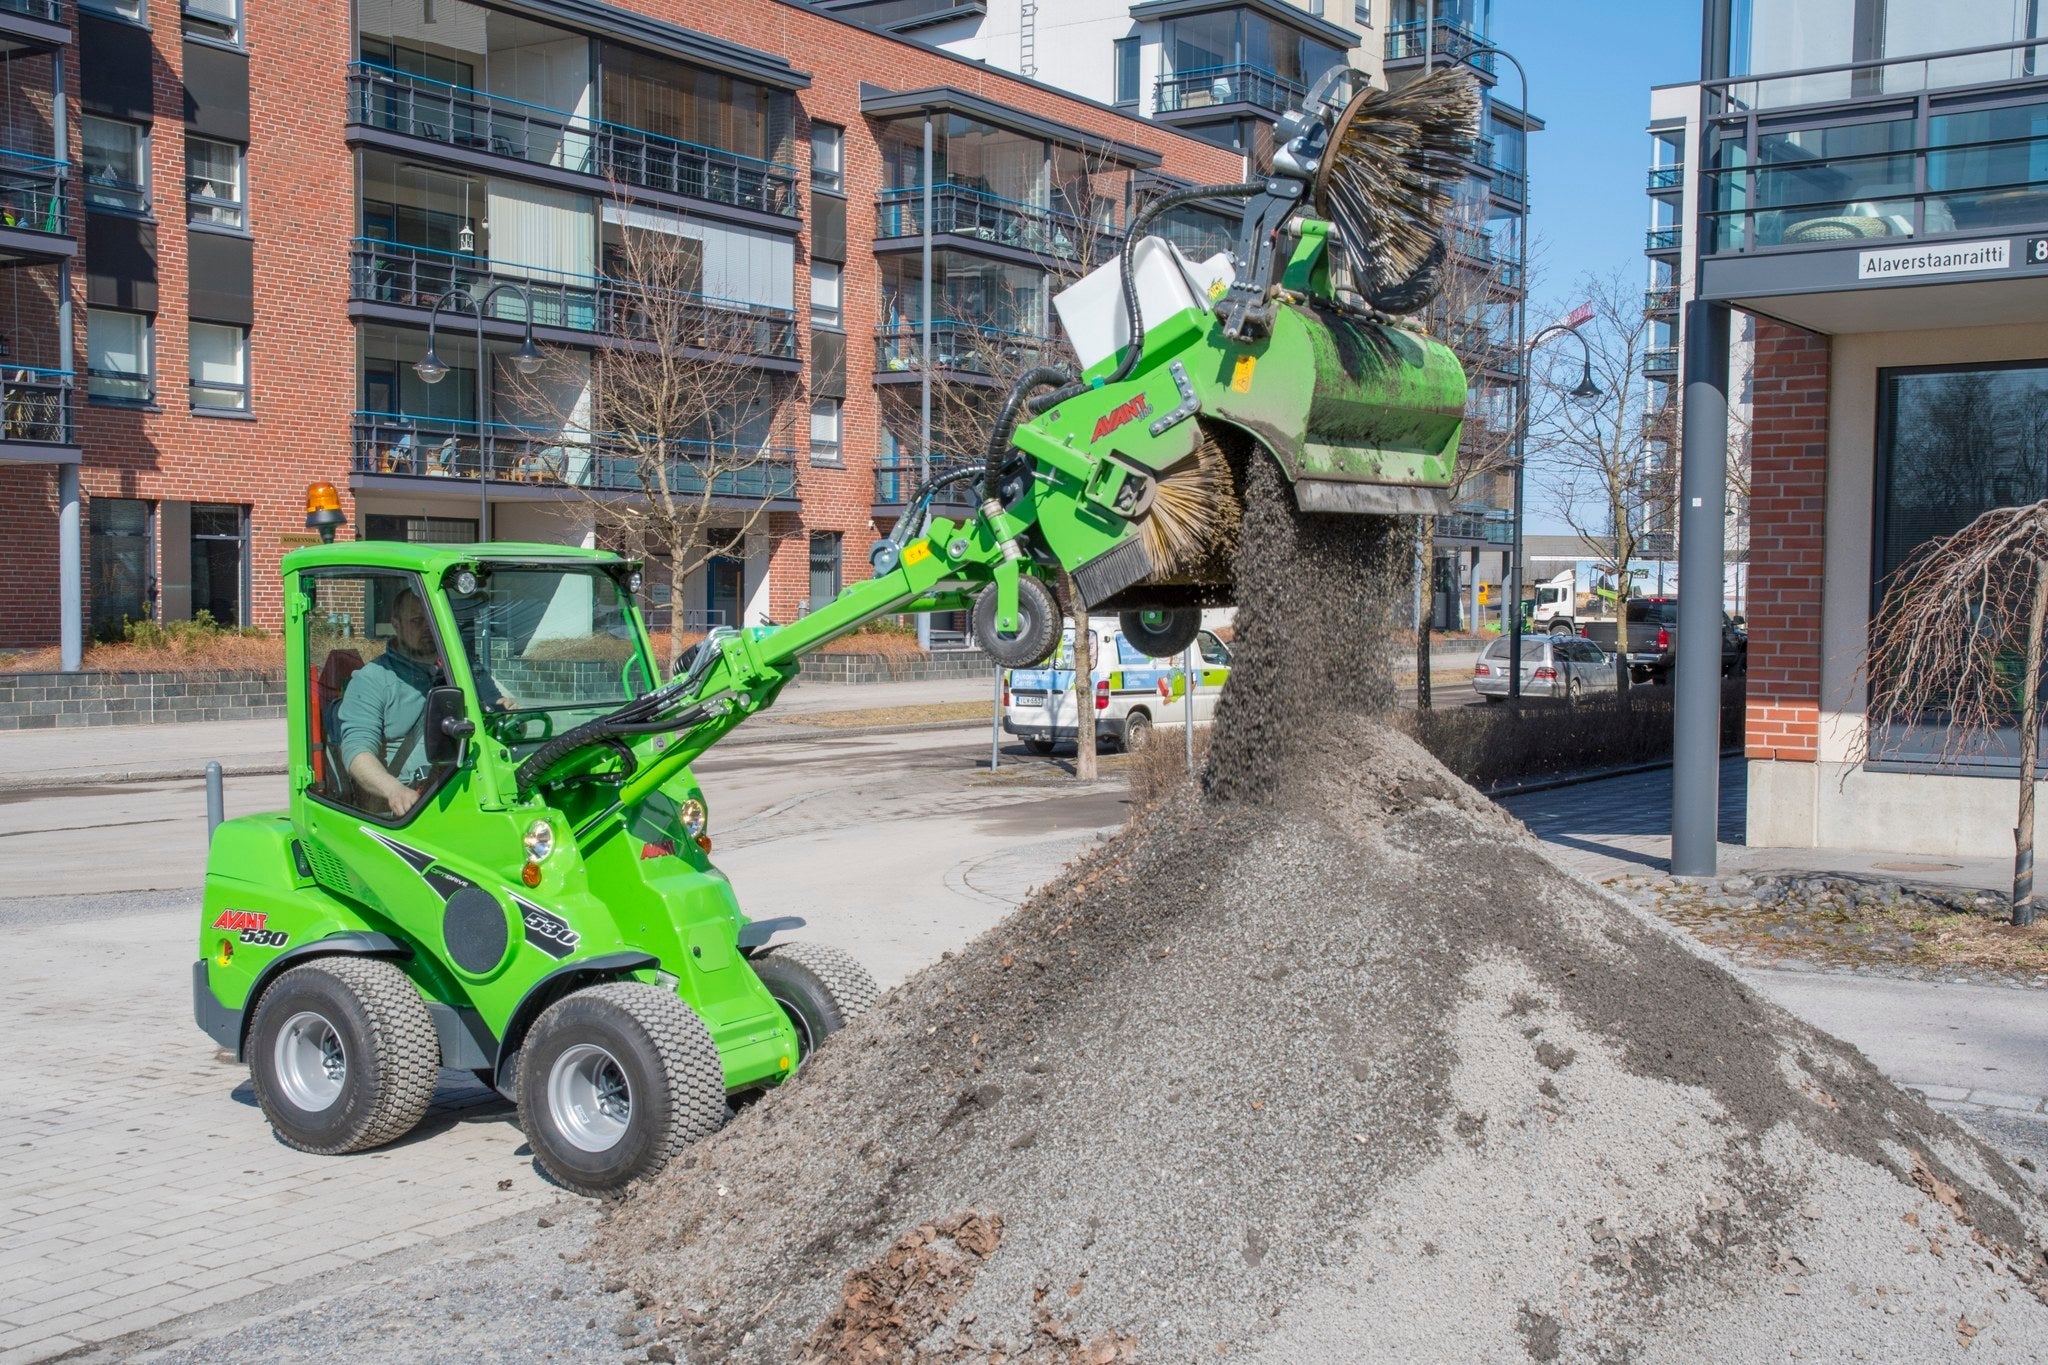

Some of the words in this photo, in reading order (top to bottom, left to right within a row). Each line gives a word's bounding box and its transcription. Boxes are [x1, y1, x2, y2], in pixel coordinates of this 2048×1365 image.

[1866, 246, 2003, 273] Alaverstaanraitti
[2035, 240, 2048, 260] 8
[1090, 393, 1146, 444] AVANT
[211, 908, 268, 932] AVANT
[524, 911, 581, 946] 530
[239, 928, 289, 948] 530
